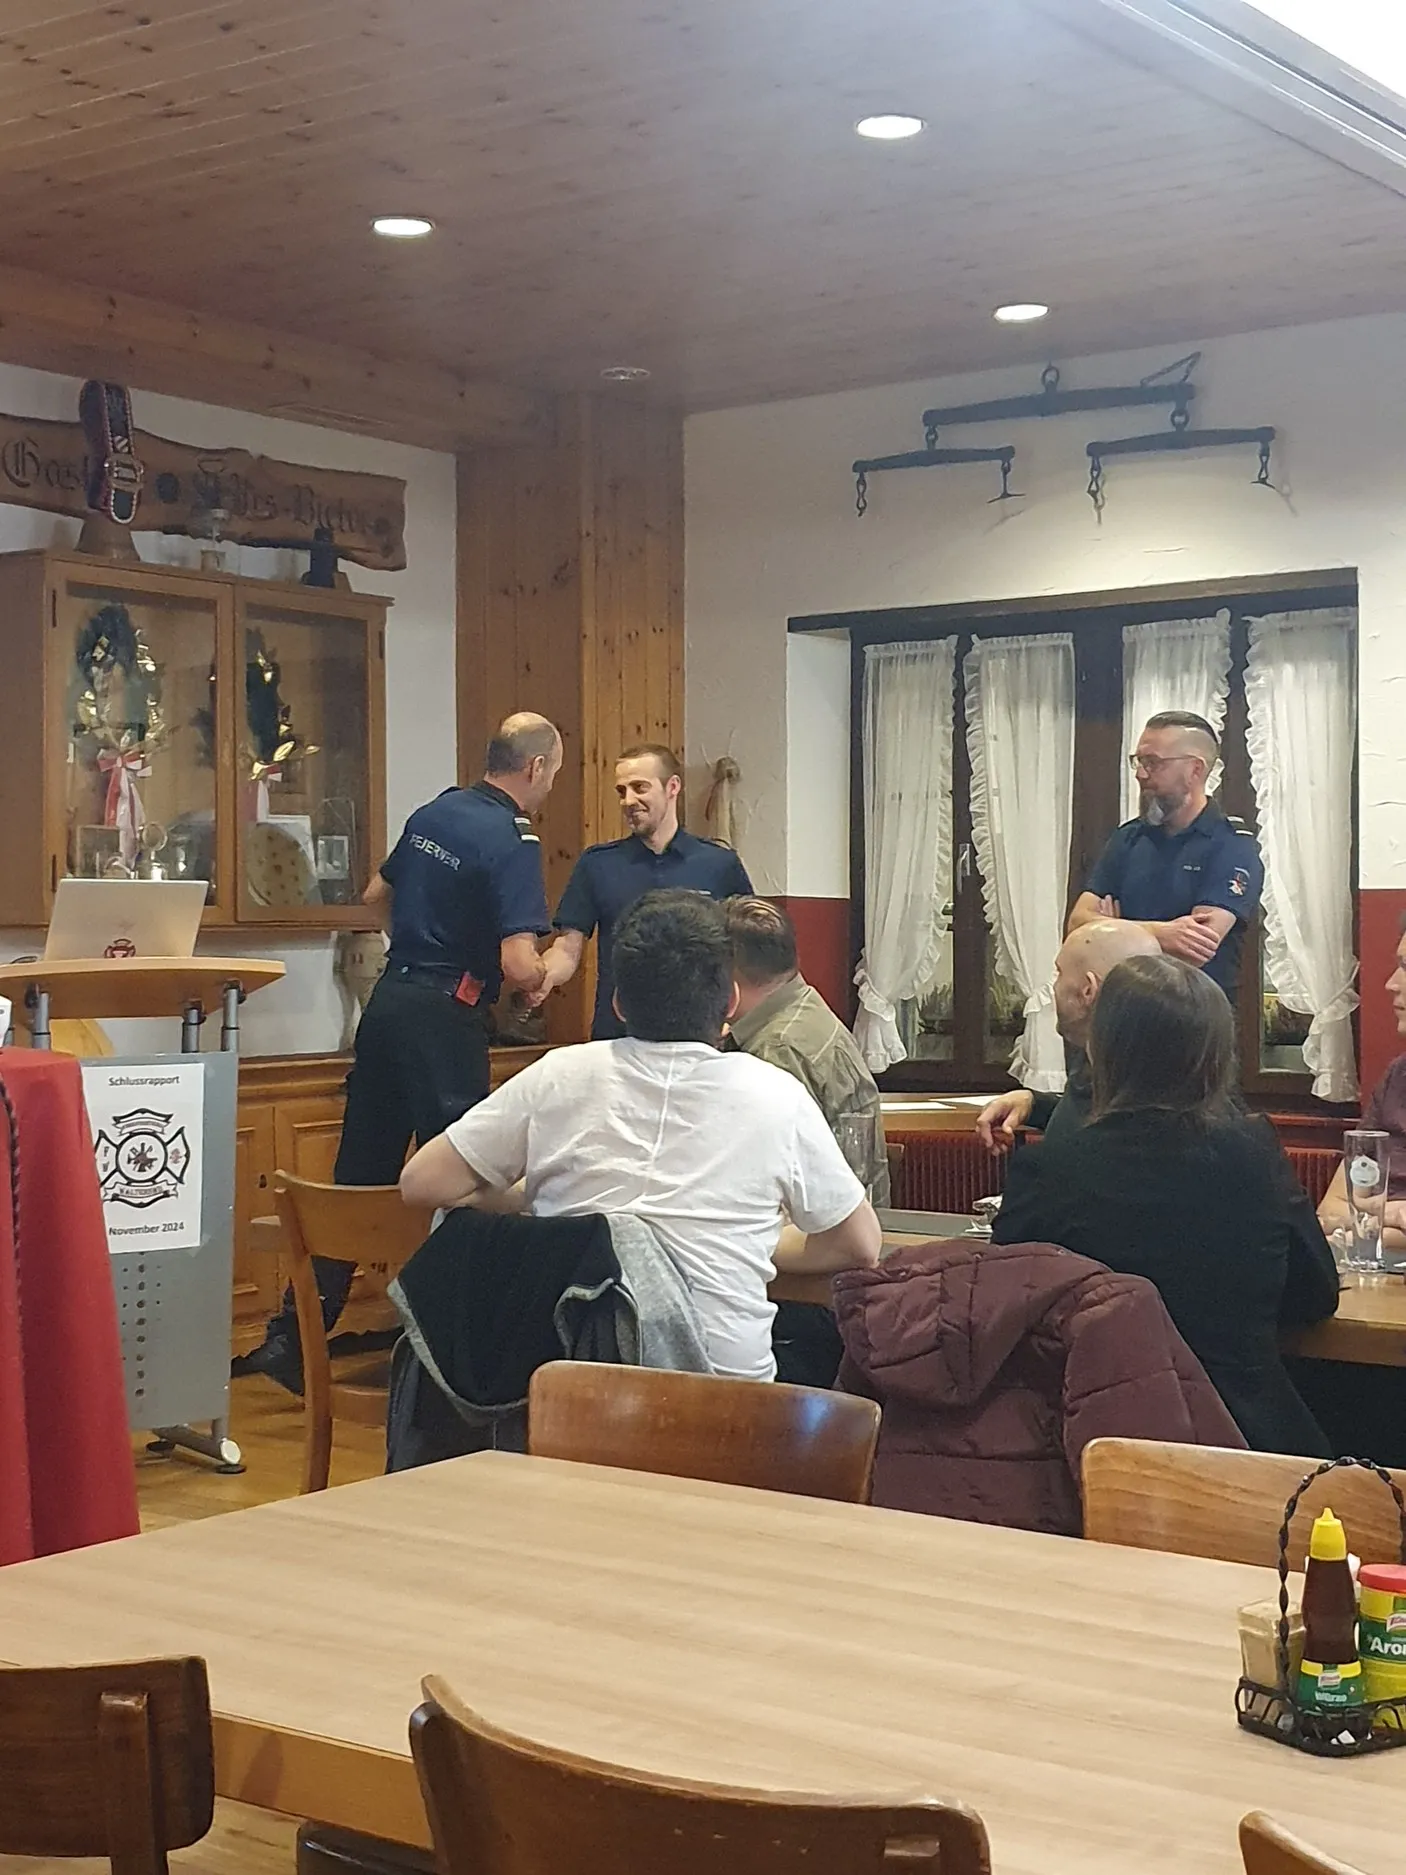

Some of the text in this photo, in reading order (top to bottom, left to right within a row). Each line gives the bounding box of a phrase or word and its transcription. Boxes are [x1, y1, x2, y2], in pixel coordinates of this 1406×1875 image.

[109, 1076, 180, 1086] Schlussrapport
[109, 1222, 185, 1235] November 2024
